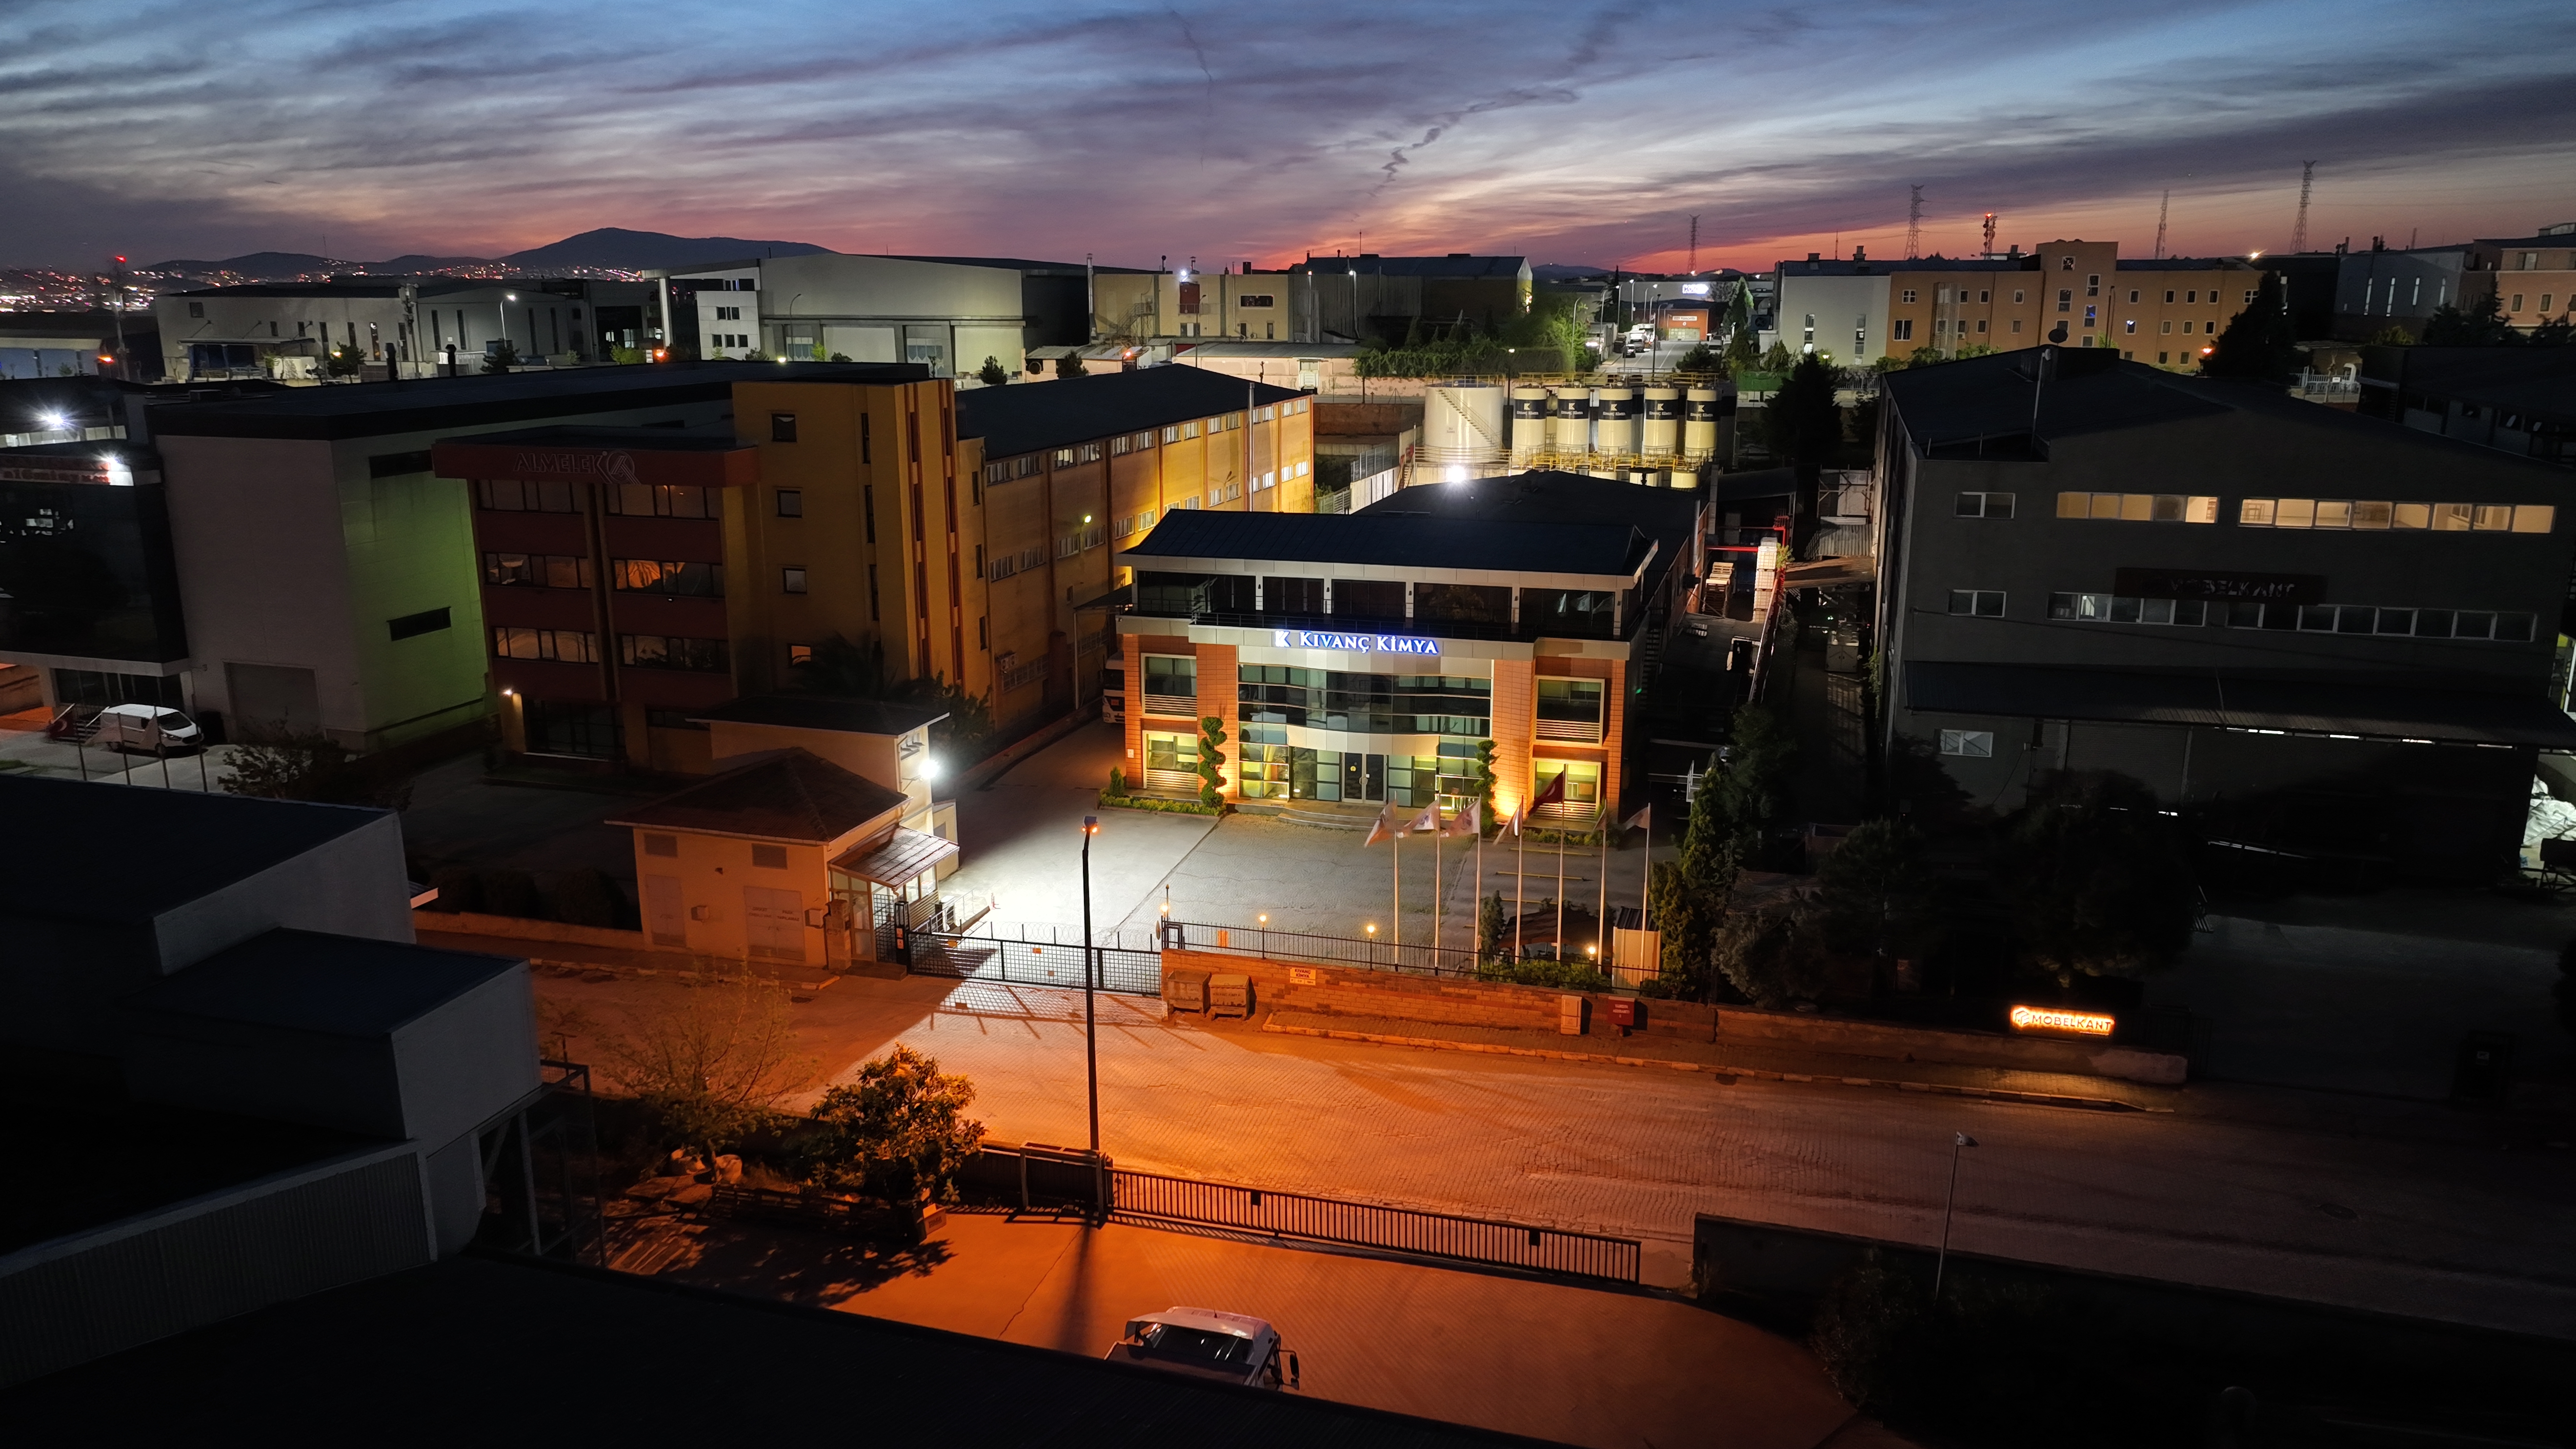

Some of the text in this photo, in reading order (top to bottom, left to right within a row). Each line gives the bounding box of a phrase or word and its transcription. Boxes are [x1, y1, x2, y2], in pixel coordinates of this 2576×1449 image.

[1299, 631, 1370, 653] KIVANÇ
[1376, 635, 1438, 654] KİMYA
[2032, 1014, 2111, 1030] MOBELKANT
